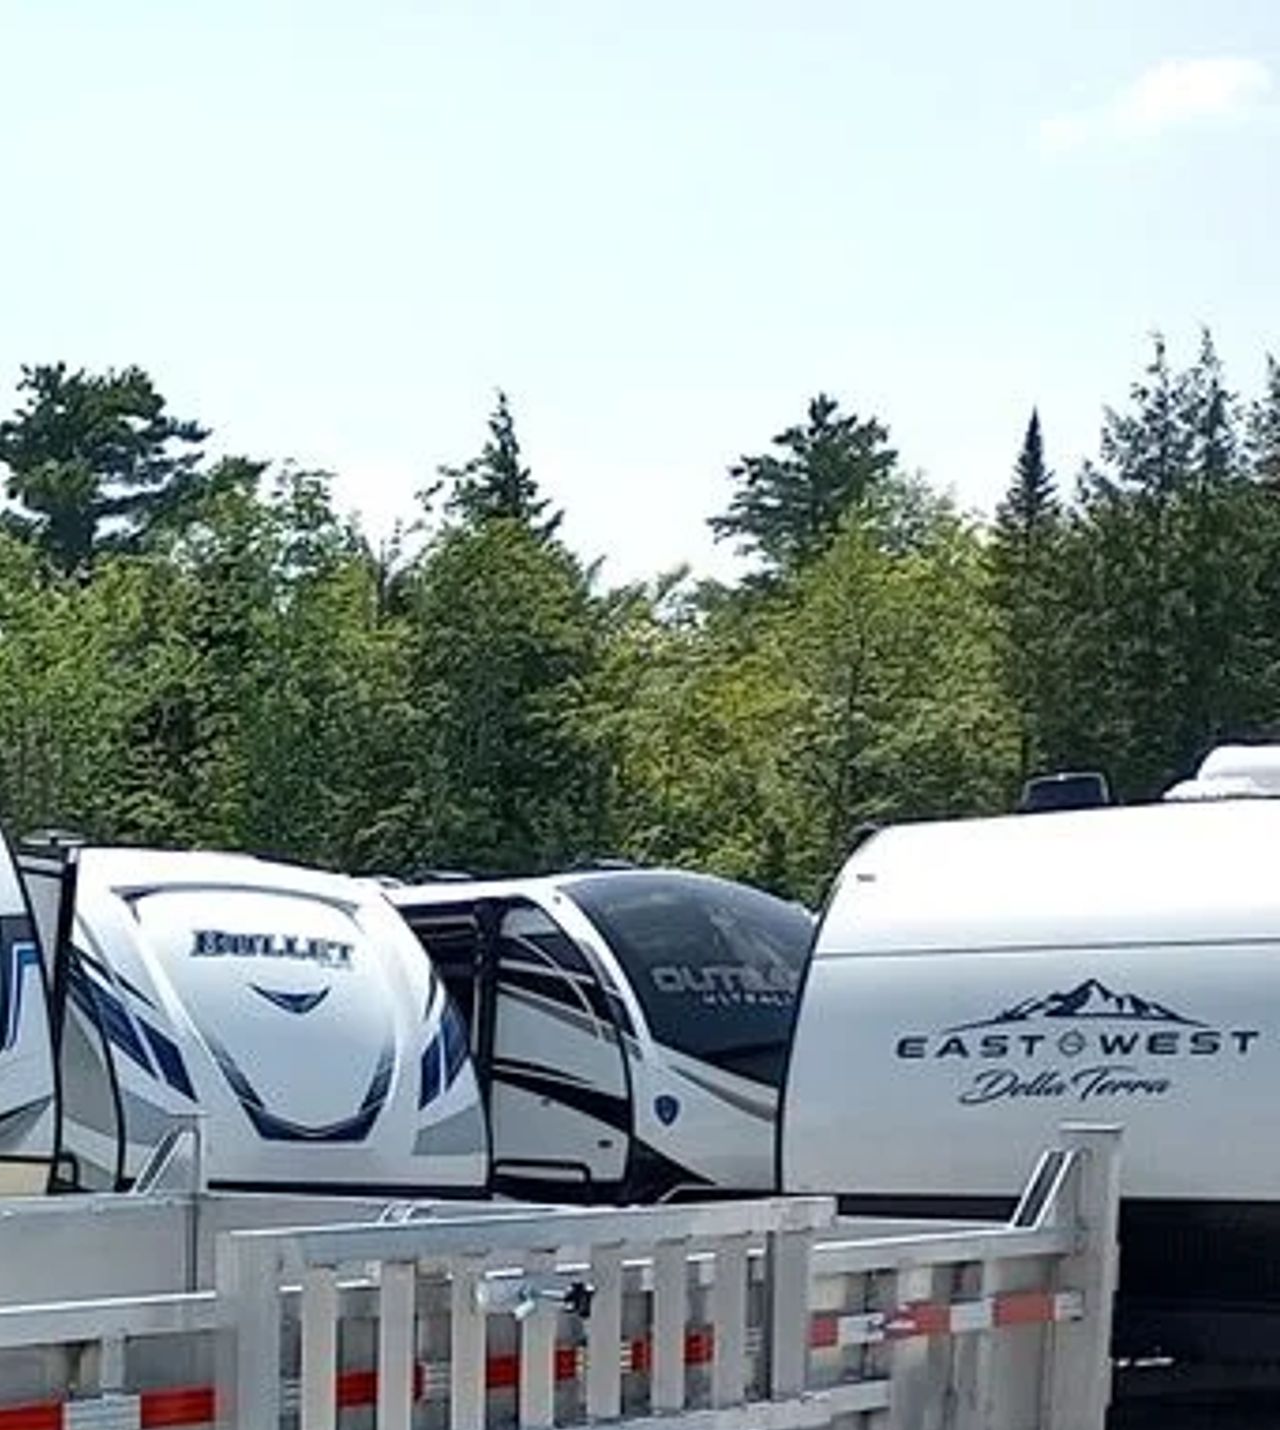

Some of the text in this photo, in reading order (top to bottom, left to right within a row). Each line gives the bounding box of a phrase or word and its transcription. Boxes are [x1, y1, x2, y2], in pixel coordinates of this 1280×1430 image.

[896, 1030, 1261, 1059] EAST WEST
[957, 1064, 1171, 1104] Della Terra
